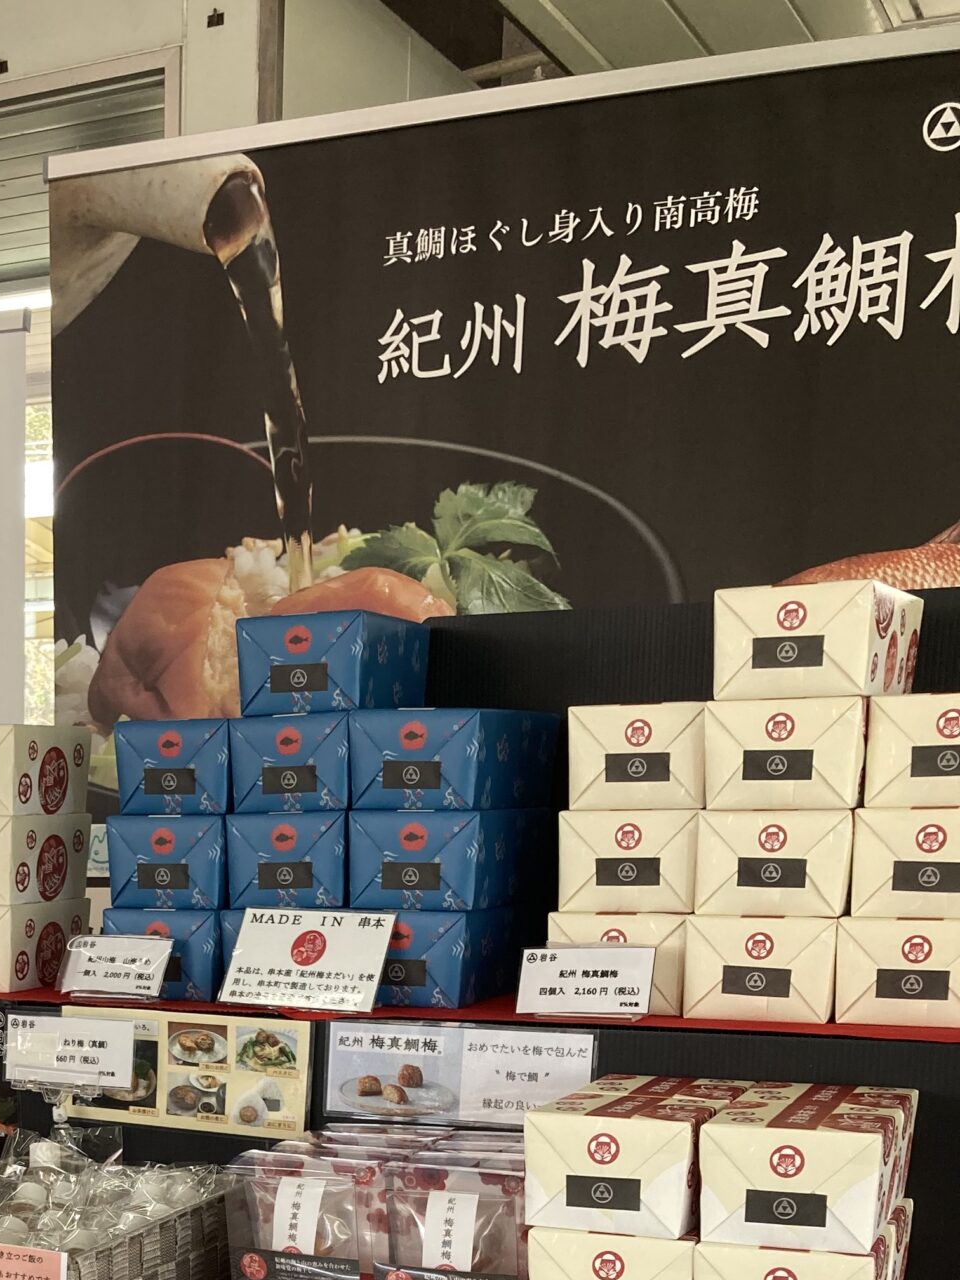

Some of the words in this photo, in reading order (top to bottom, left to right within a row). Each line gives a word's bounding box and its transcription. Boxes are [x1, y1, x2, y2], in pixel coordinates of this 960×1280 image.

[384, 187, 761, 266] 真鯛ほぐし身入り南高梅
[378, 293, 528, 384] 紀州
[249, 912, 303, 926] MADE
[320, 915, 345, 928] IN
[358, 916, 386, 930] 串本
[338, 1035, 364, 1048] 紀州
[368, 1034, 439, 1053] 梅真鯛梅
[467, 1042, 588, 1059] おめでたいを梅で包んだ
